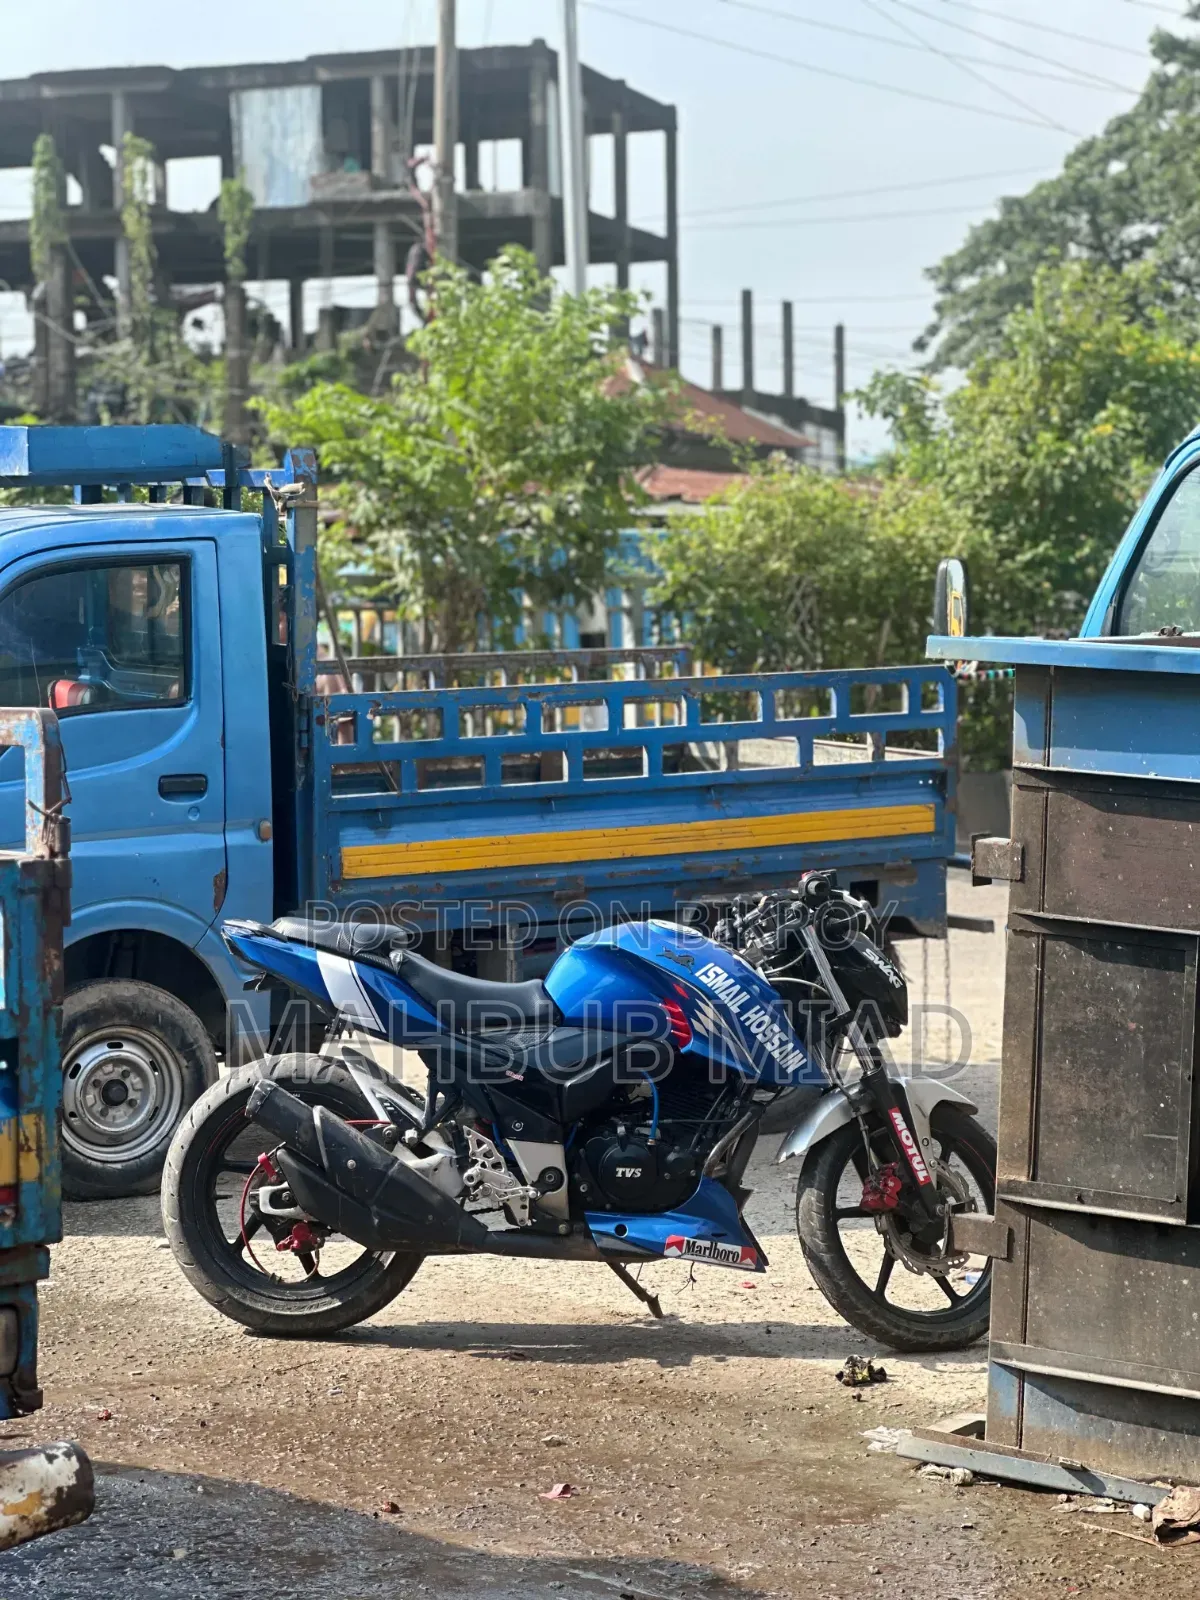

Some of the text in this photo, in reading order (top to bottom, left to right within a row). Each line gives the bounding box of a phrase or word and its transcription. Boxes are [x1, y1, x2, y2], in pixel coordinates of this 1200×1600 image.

[862, 948, 903, 989] SWAG
[695, 962, 807, 1074] ISMAIL HOSSAIN
[891, 1112, 929, 1182] MOTUL
[615, 1167, 642, 1178] TVS
[684, 1239, 740, 1263] Marlboro
